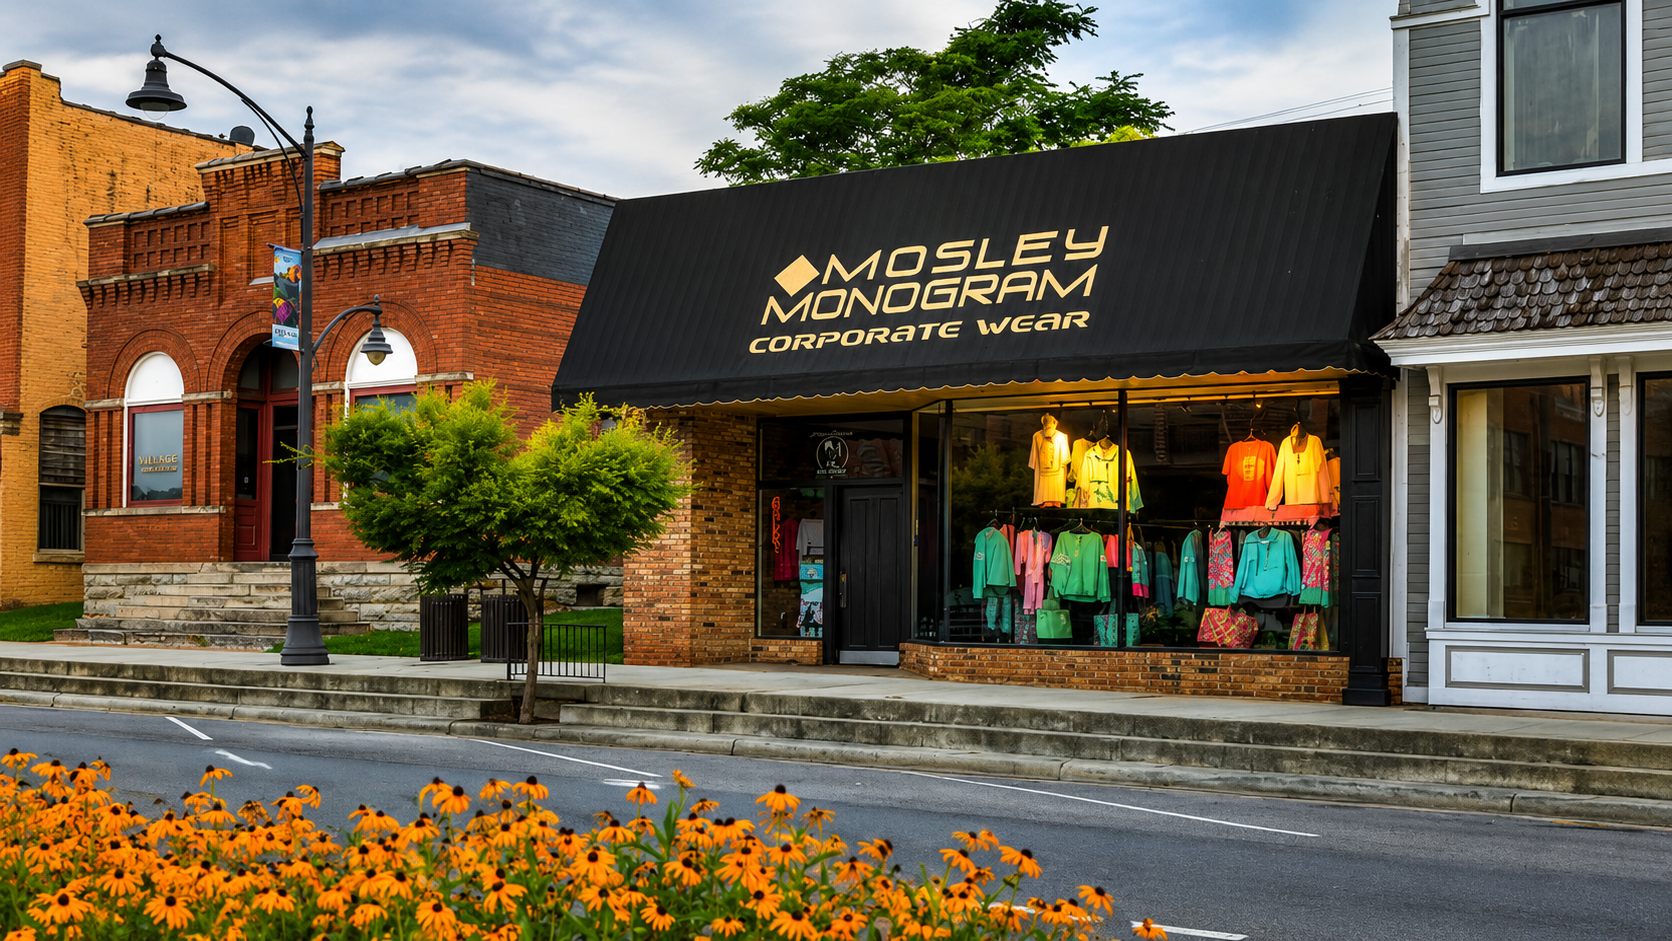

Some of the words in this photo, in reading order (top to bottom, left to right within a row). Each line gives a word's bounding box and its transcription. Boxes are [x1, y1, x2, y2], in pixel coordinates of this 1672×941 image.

[821, 225, 1109, 285] MOSLEY
[760, 263, 1098, 325] MONOGRAM
[748, 320, 964, 354] CORPORATE
[976, 310, 1091, 336] WEAR
[138, 454, 178, 465] VILLAGE
